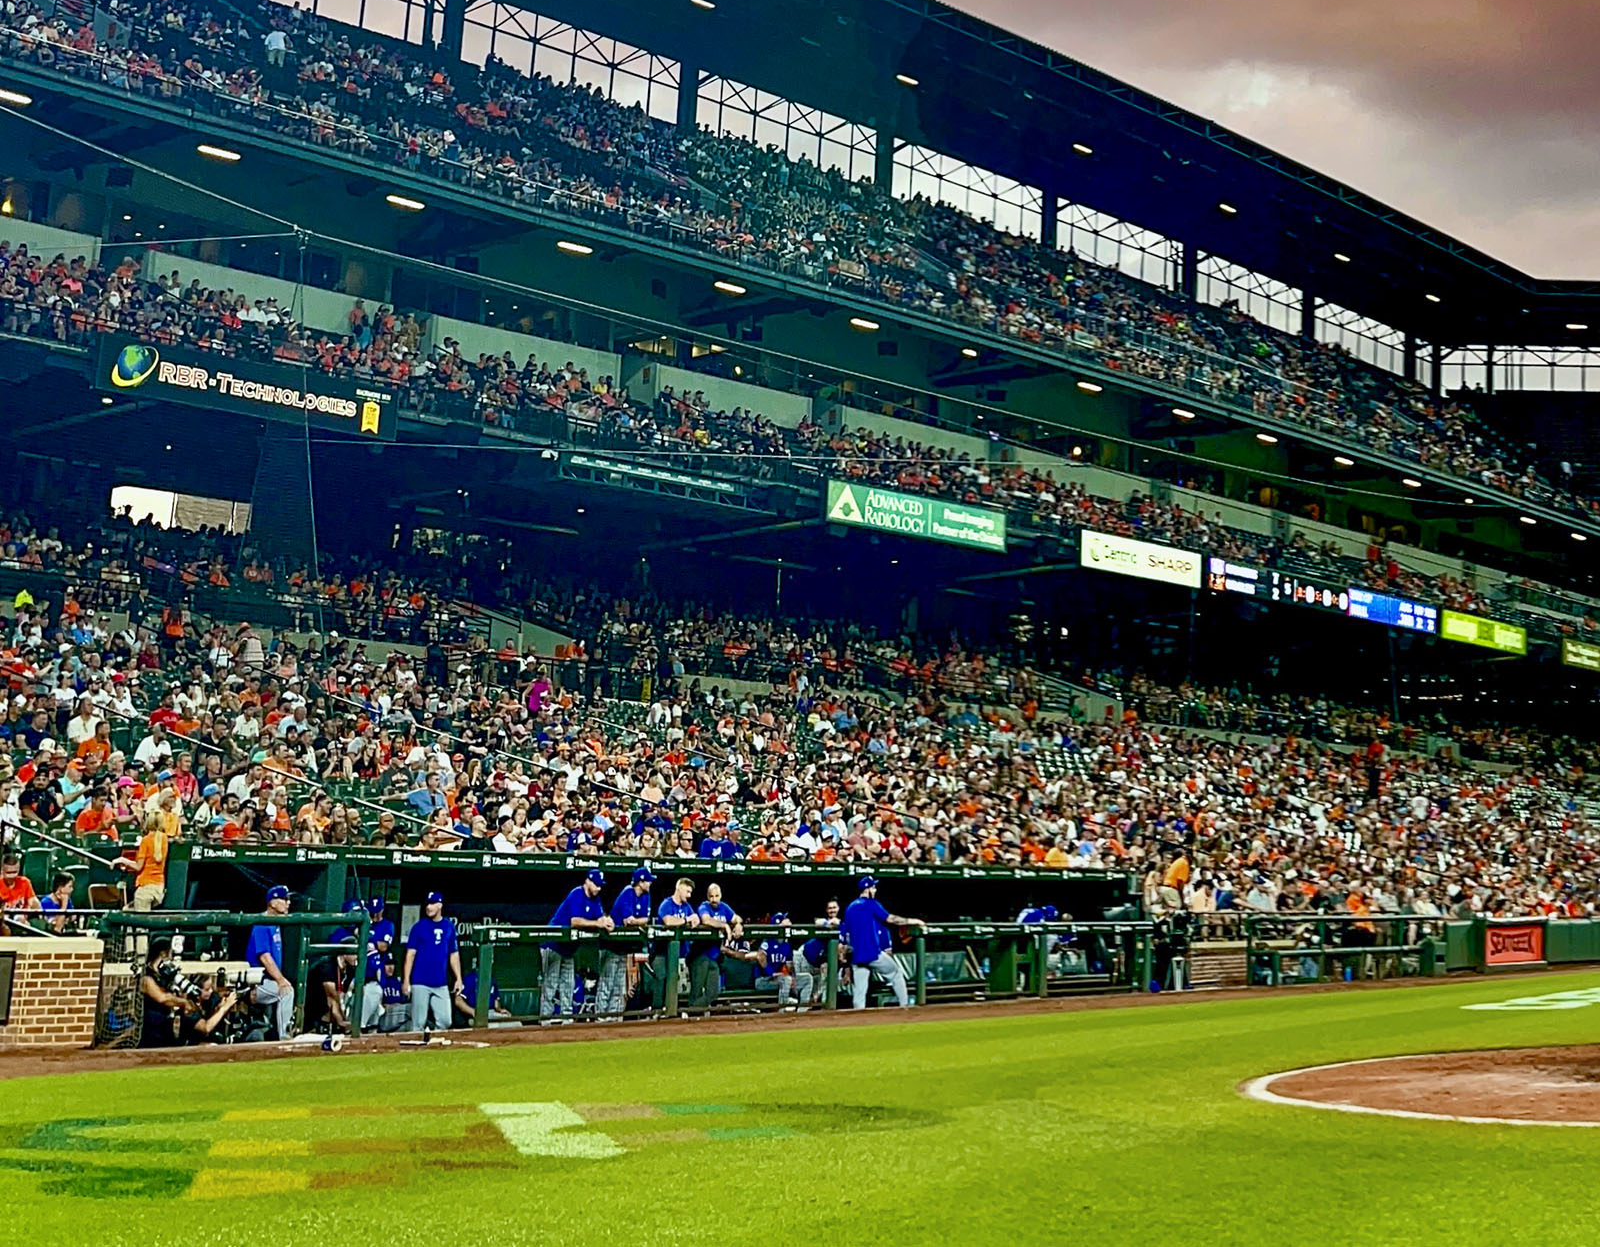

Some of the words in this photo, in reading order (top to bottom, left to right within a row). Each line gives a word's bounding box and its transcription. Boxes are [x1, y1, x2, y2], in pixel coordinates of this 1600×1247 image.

[865, 489, 923, 515] ADVANCED
[864, 506, 926, 533] RADIOLOGY
[1147, 554, 1193, 575] SHARP
[1272, 589, 1280, 601] 2
